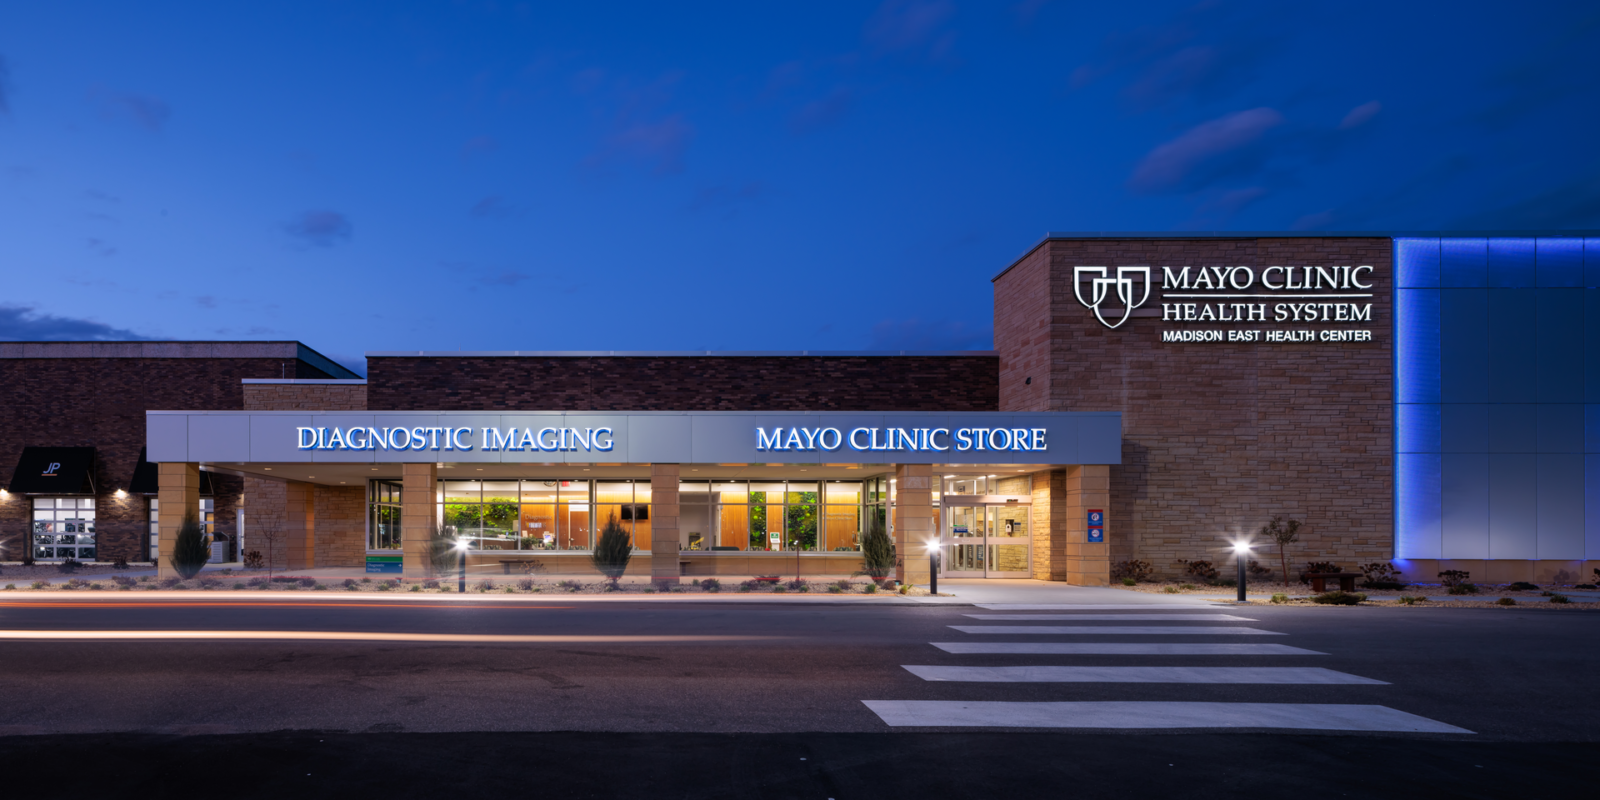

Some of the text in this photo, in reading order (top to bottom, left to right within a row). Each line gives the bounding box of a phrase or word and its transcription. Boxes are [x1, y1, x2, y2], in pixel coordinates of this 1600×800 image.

[1162, 265, 1374, 290] MAYO CLINIC
[1162, 302, 1373, 322] HEALTH SYSTEM
[1163, 329, 1372, 342] MADISON EAST HEALTH CENTER
[296, 426, 614, 450] DIAGNOSTIC IMAGING
[756, 427, 1047, 451] MAYO CLINIC STORE
[42, 462, 61, 474] JP
